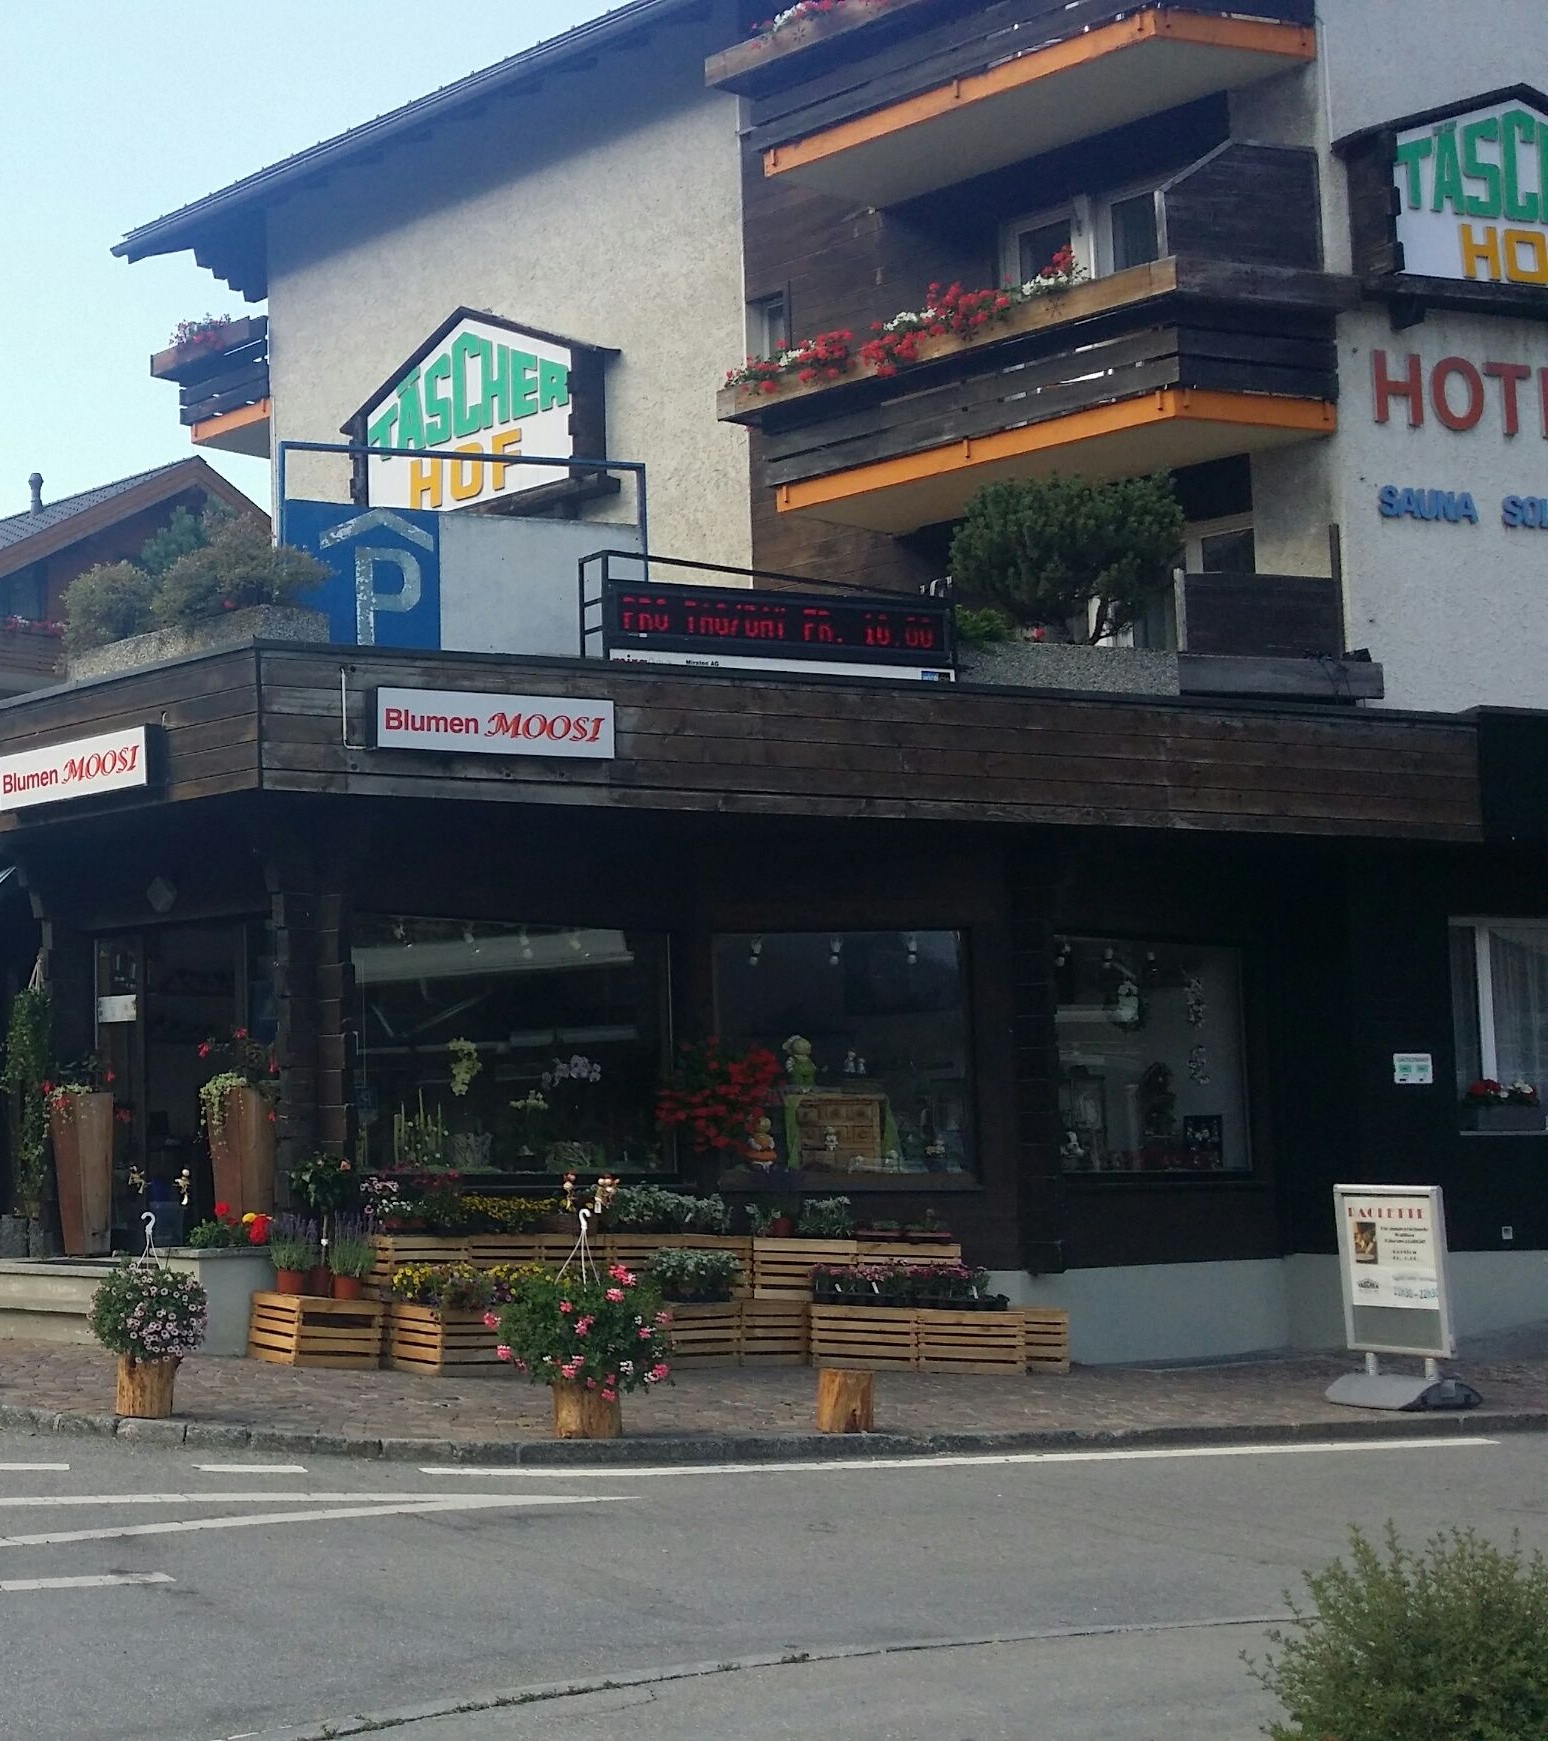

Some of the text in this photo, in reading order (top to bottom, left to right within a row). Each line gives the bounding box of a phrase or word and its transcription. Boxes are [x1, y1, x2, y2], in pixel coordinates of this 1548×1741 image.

[1395, 109, 1548, 224] TÄSC
[369, 331, 570, 461] TÄSCHER
[1372, 350, 1548, 440] HOT
[410, 428, 523, 510] HOF
[1378, 485, 1480, 525] SAUNA
[385, 708, 605, 742] Blumen MOOSI
[3, 745, 140, 794] Blumen MOOSI
